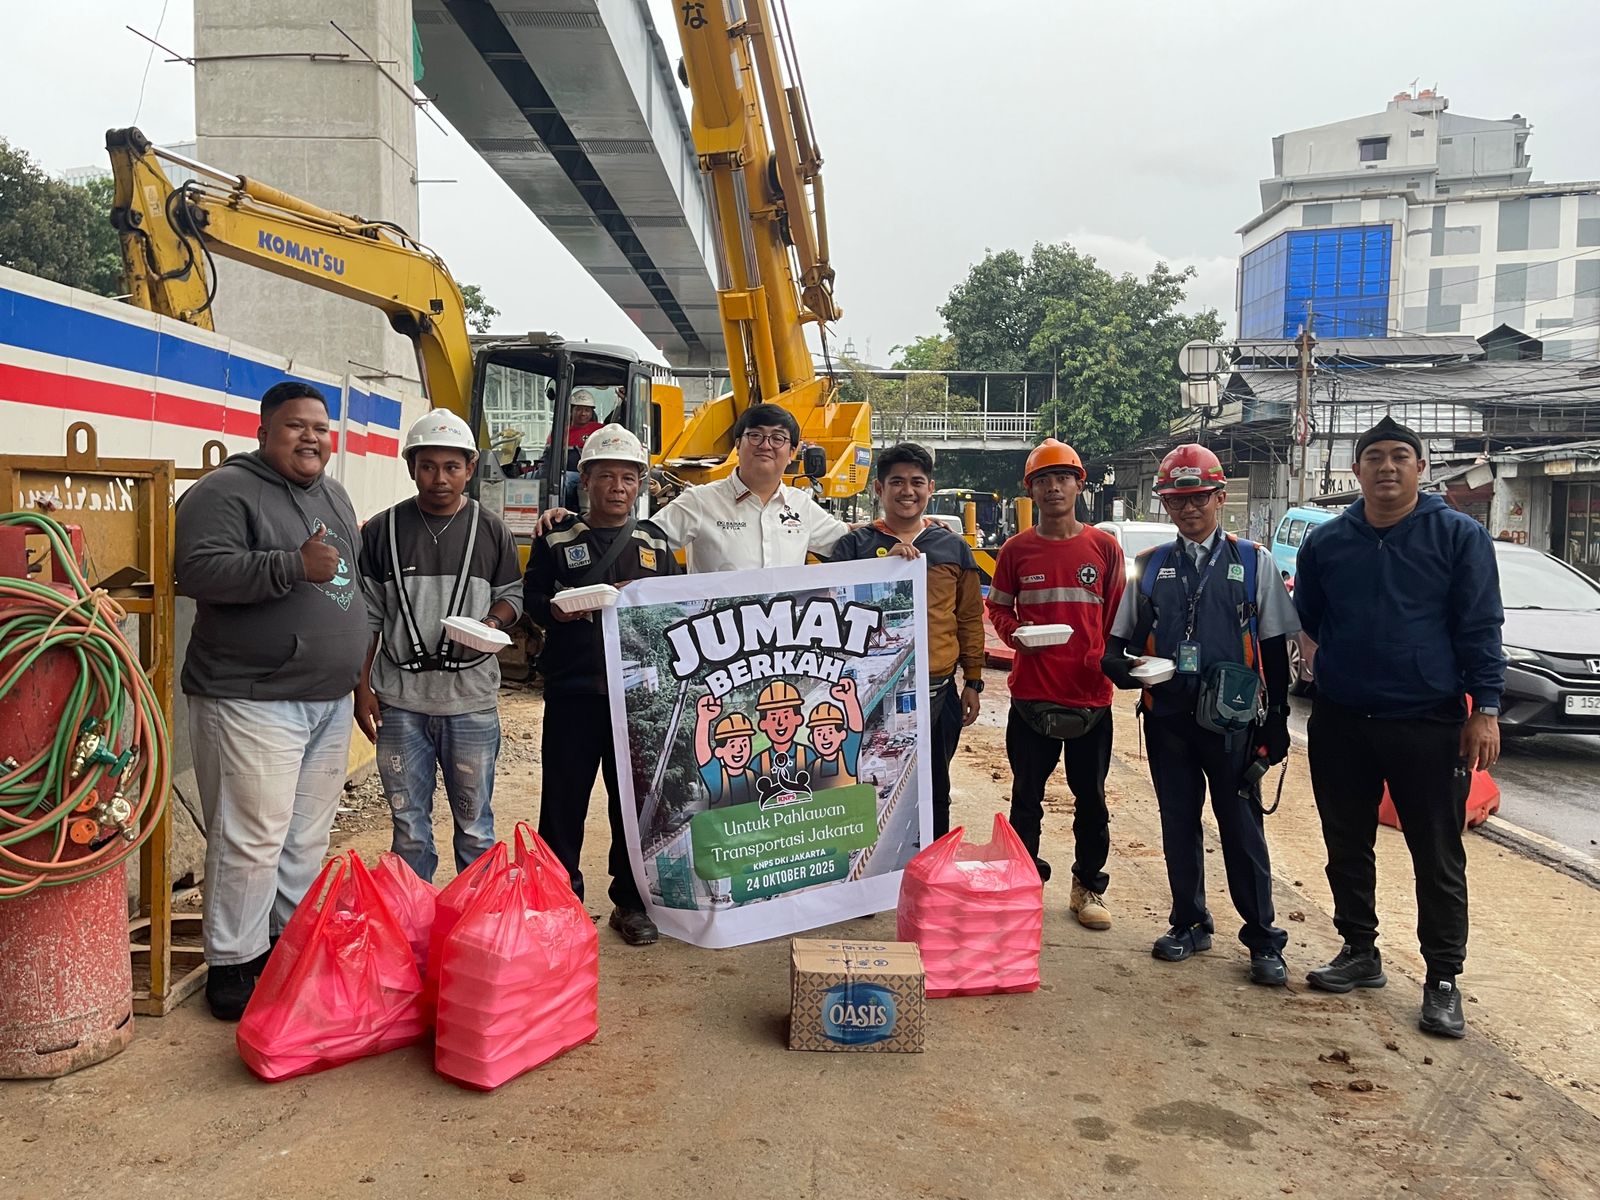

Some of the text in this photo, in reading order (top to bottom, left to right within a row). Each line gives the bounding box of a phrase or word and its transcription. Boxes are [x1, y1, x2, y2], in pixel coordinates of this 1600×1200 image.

[681, 1, 708, 29] な
[258, 230, 345, 275] KOMATSU
[666, 599, 880, 678] JUMAT
[704, 650, 845, 699] BERKAH
[1567, 696, 1574, 708] B
[777, 793, 797, 802] KNPS
[723, 804, 846, 837] Untuk Pahlawan
[711, 822, 864, 862] Transportasi Jakarta
[746, 859, 835, 892] 24 OKTOBER 2025
[753, 848, 826, 871] KNPS DKI JAKARTA
[829, 1004, 888, 1027] OASIS
